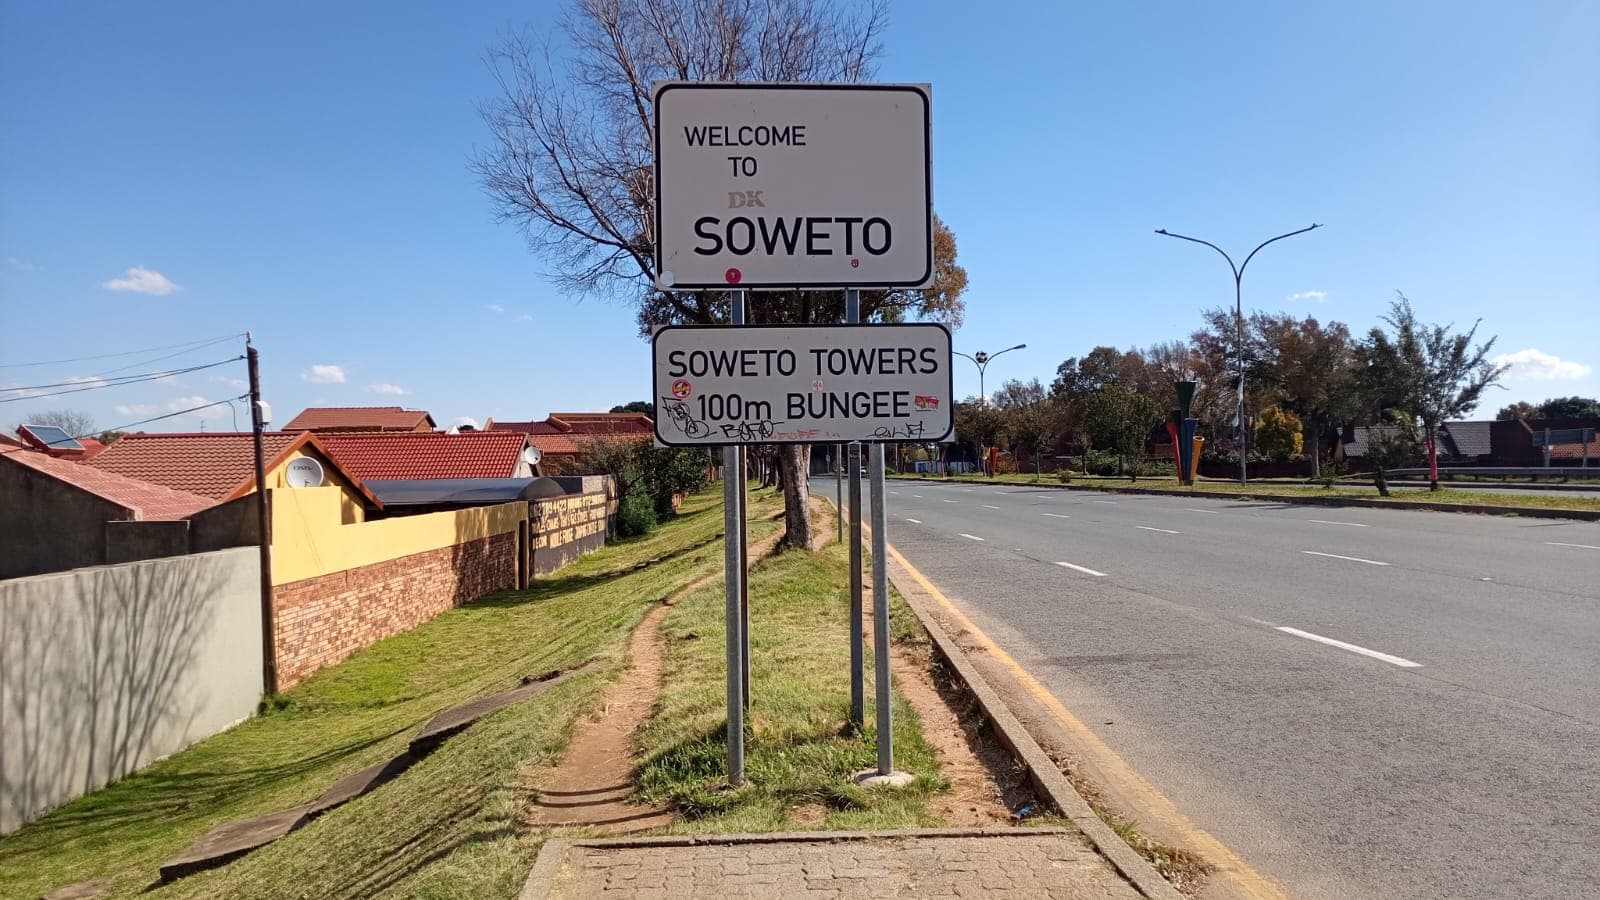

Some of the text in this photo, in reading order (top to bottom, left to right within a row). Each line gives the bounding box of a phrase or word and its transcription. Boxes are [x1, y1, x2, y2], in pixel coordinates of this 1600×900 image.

[684, 125, 806, 147] WELCOME
[728, 157, 758, 178] TO
[727, 191, 766, 208] DK
[694, 216, 892, 256] SOWETO
[668, 347, 939, 378] SOWETO TOWERS
[698, 393, 772, 421] 100m
[786, 391, 911, 420] BUNGEE
